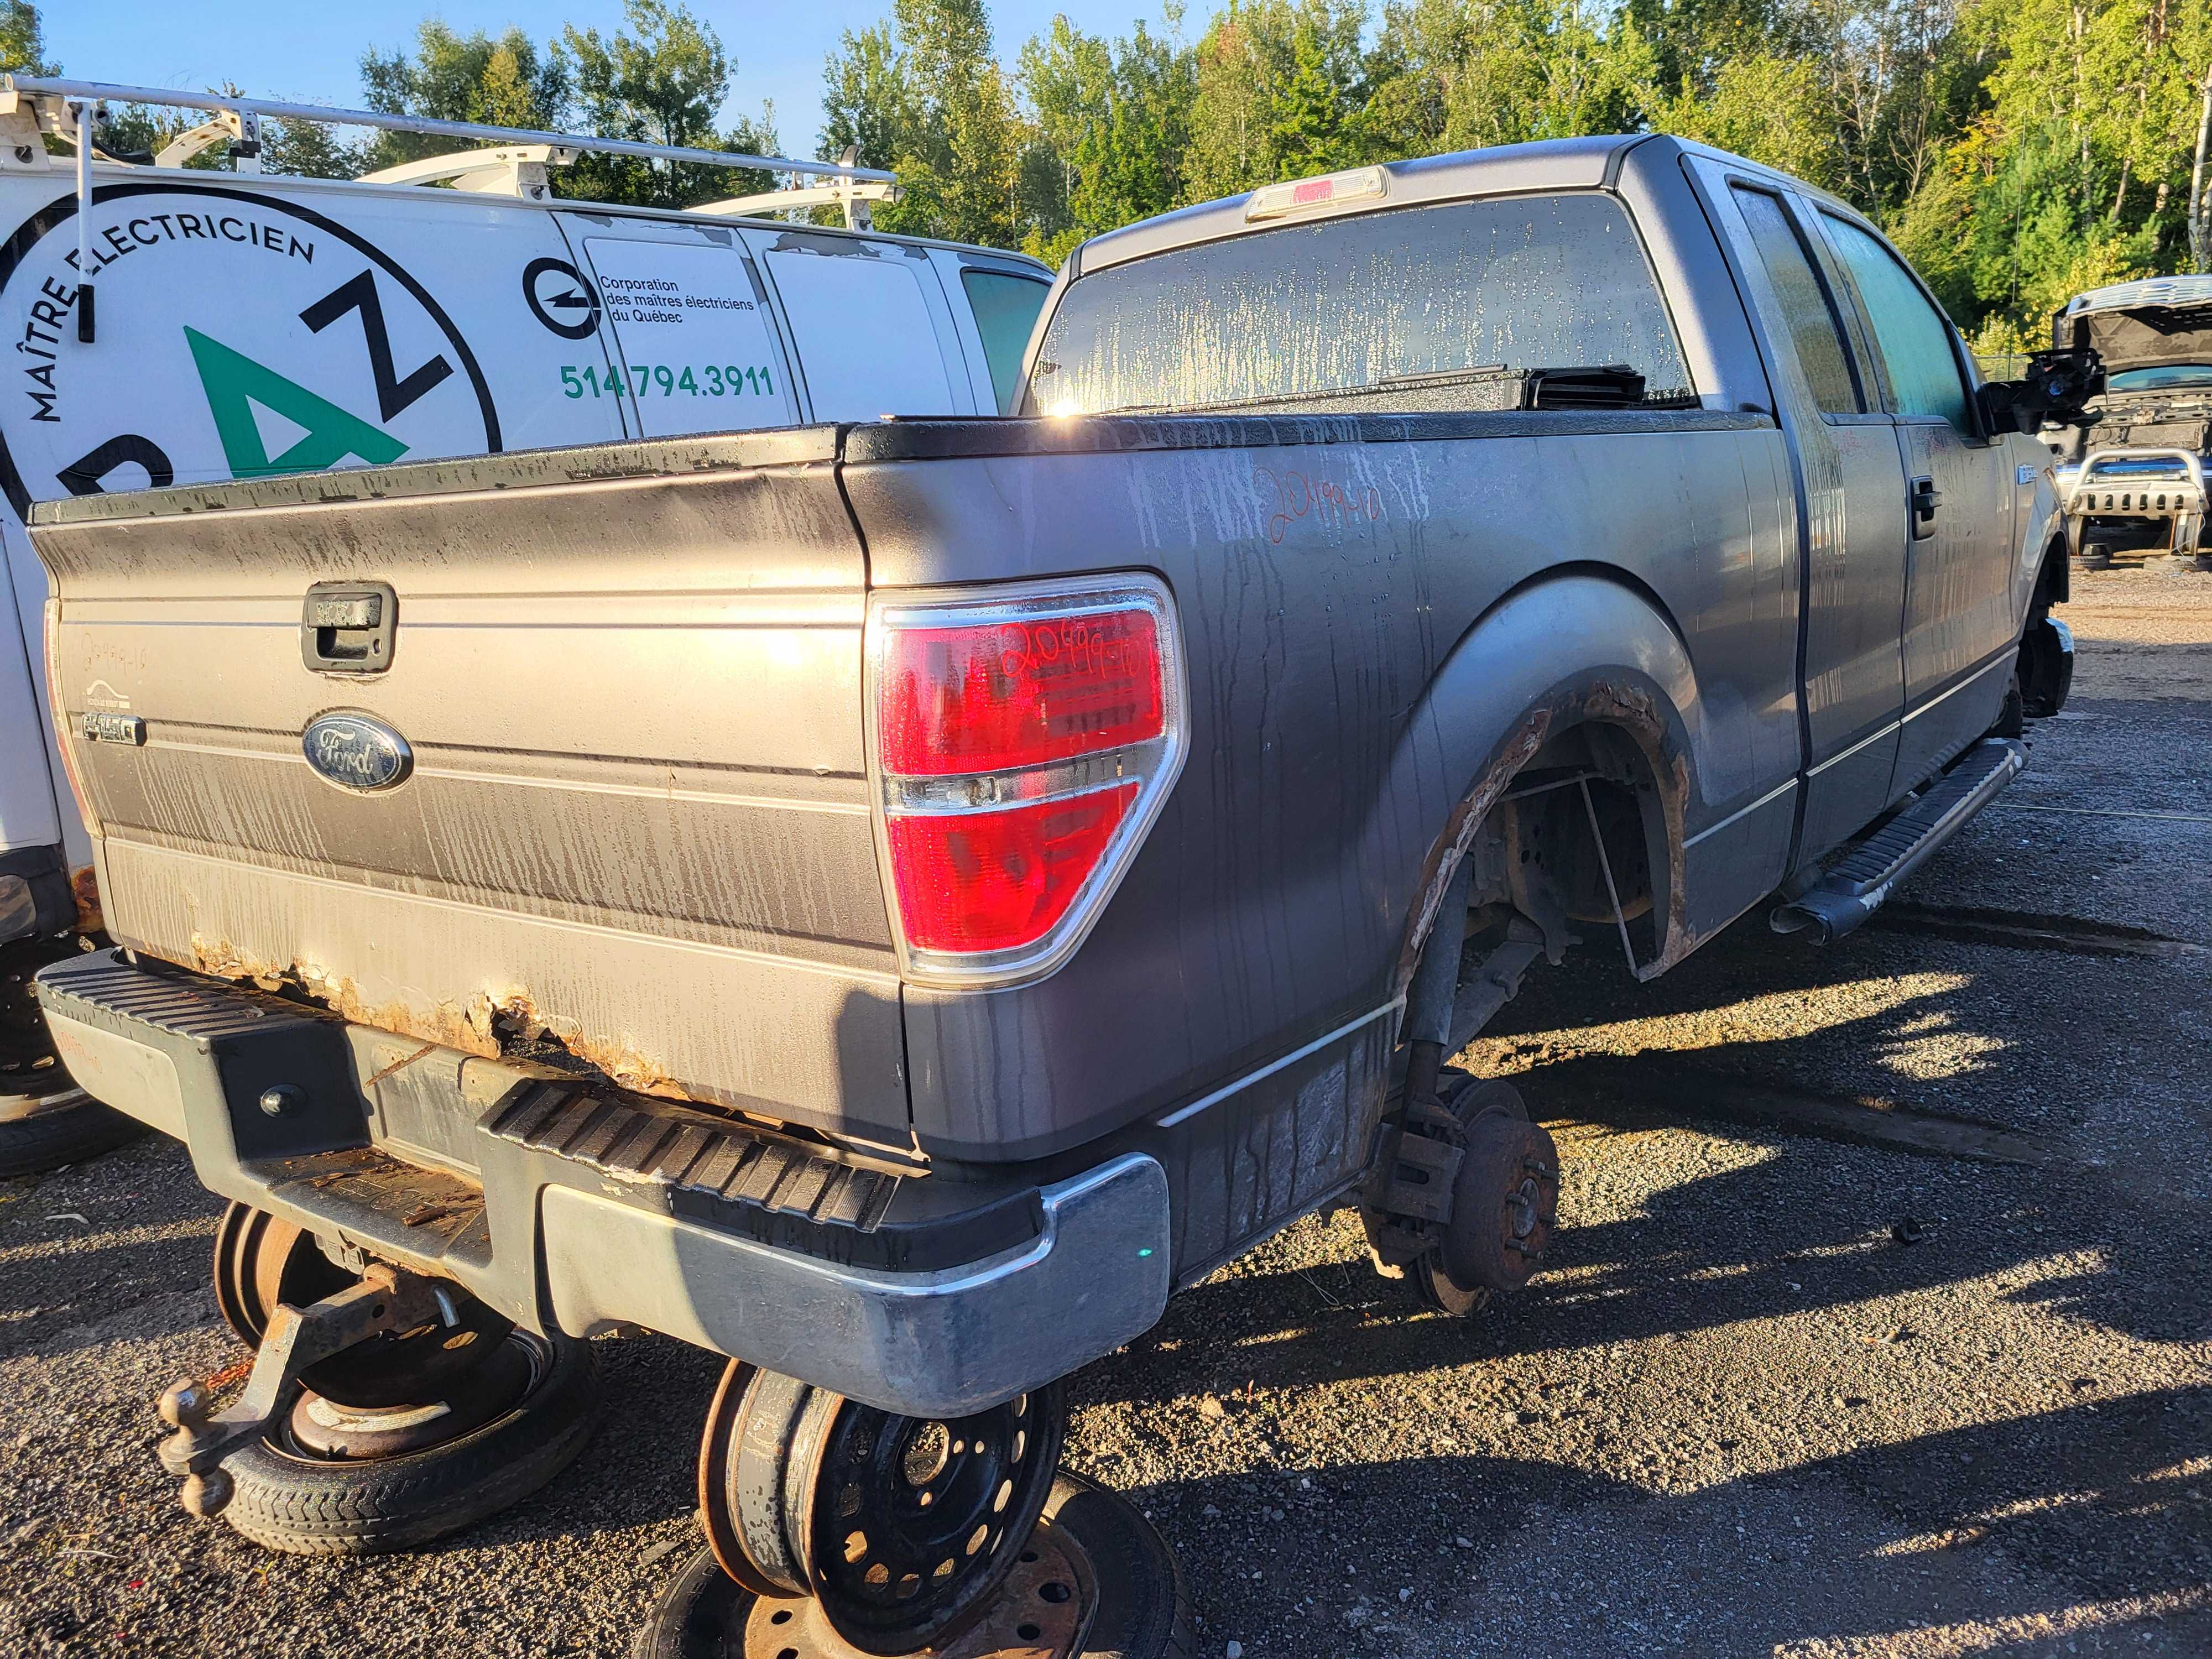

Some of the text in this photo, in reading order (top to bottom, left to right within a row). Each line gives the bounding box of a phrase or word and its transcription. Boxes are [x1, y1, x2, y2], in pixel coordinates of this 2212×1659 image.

[600, 276, 679, 292] Corporation
[607, 293, 754, 310] des maîtres électriciens
[612, 309, 683, 324] du Québec
[16, 276, 79, 422] MAÎTRE
[316, 728, 373, 774] Ford
